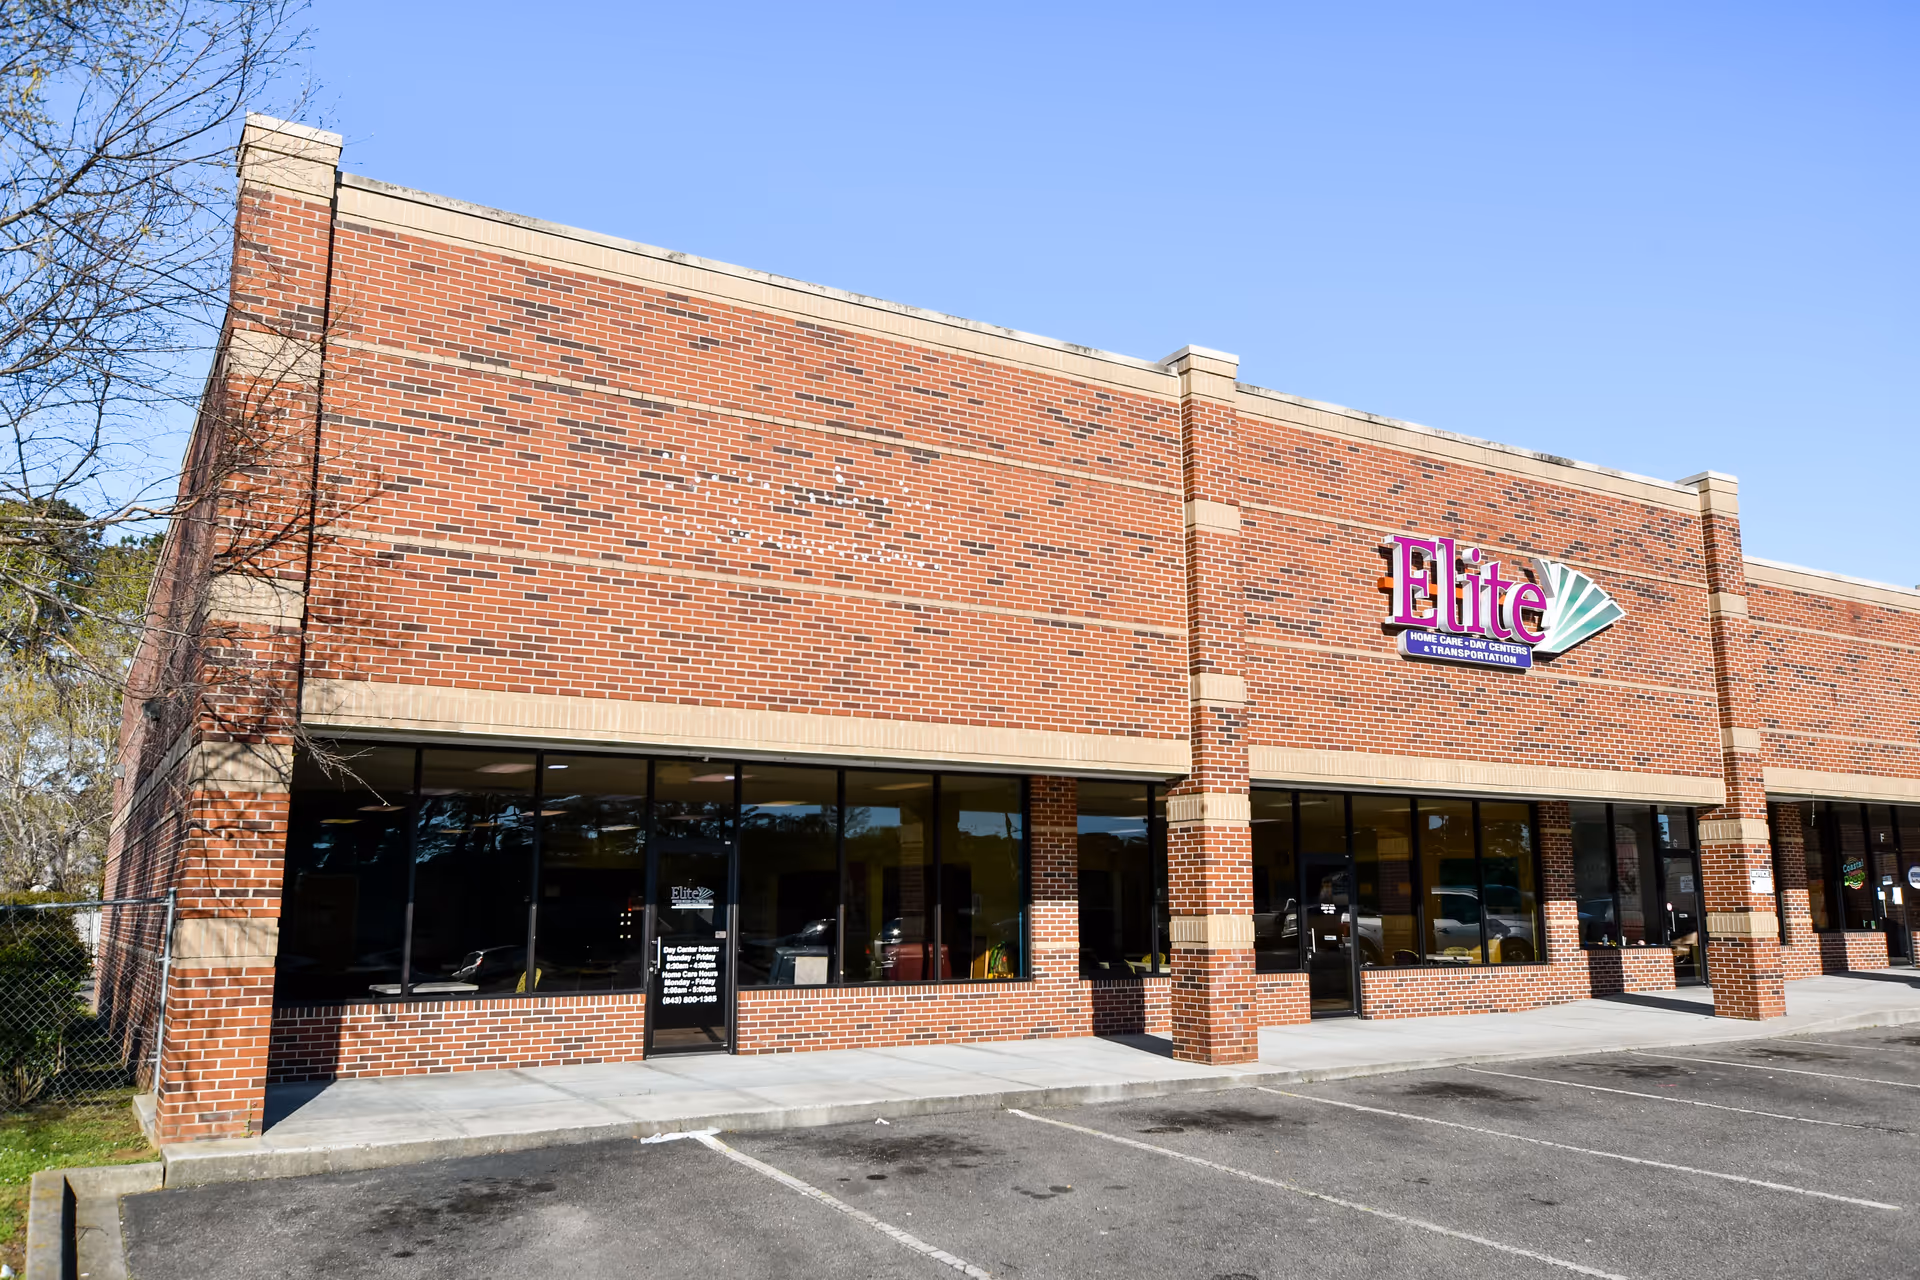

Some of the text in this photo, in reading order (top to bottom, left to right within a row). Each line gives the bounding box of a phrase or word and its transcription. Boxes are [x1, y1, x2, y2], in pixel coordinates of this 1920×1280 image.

[1384, 535, 1548, 644] Elite
[1410, 632, 1528, 655] HOME CARE DAY CENTERS
[1423, 645, 1517, 664] & TRANSPORTATION
[1879, 833, 1885, 842] F
[671, 886, 699, 900] Elite
[663, 946, 676, 954] Day
[666, 954, 692, 962] Monday
[696, 953, 716, 961] Friday
[682, 970, 698, 978] Care
[664, 978, 690, 987] Monday
[695, 977, 716, 986] Friday
[662, 995, 682, 1005] (843)
